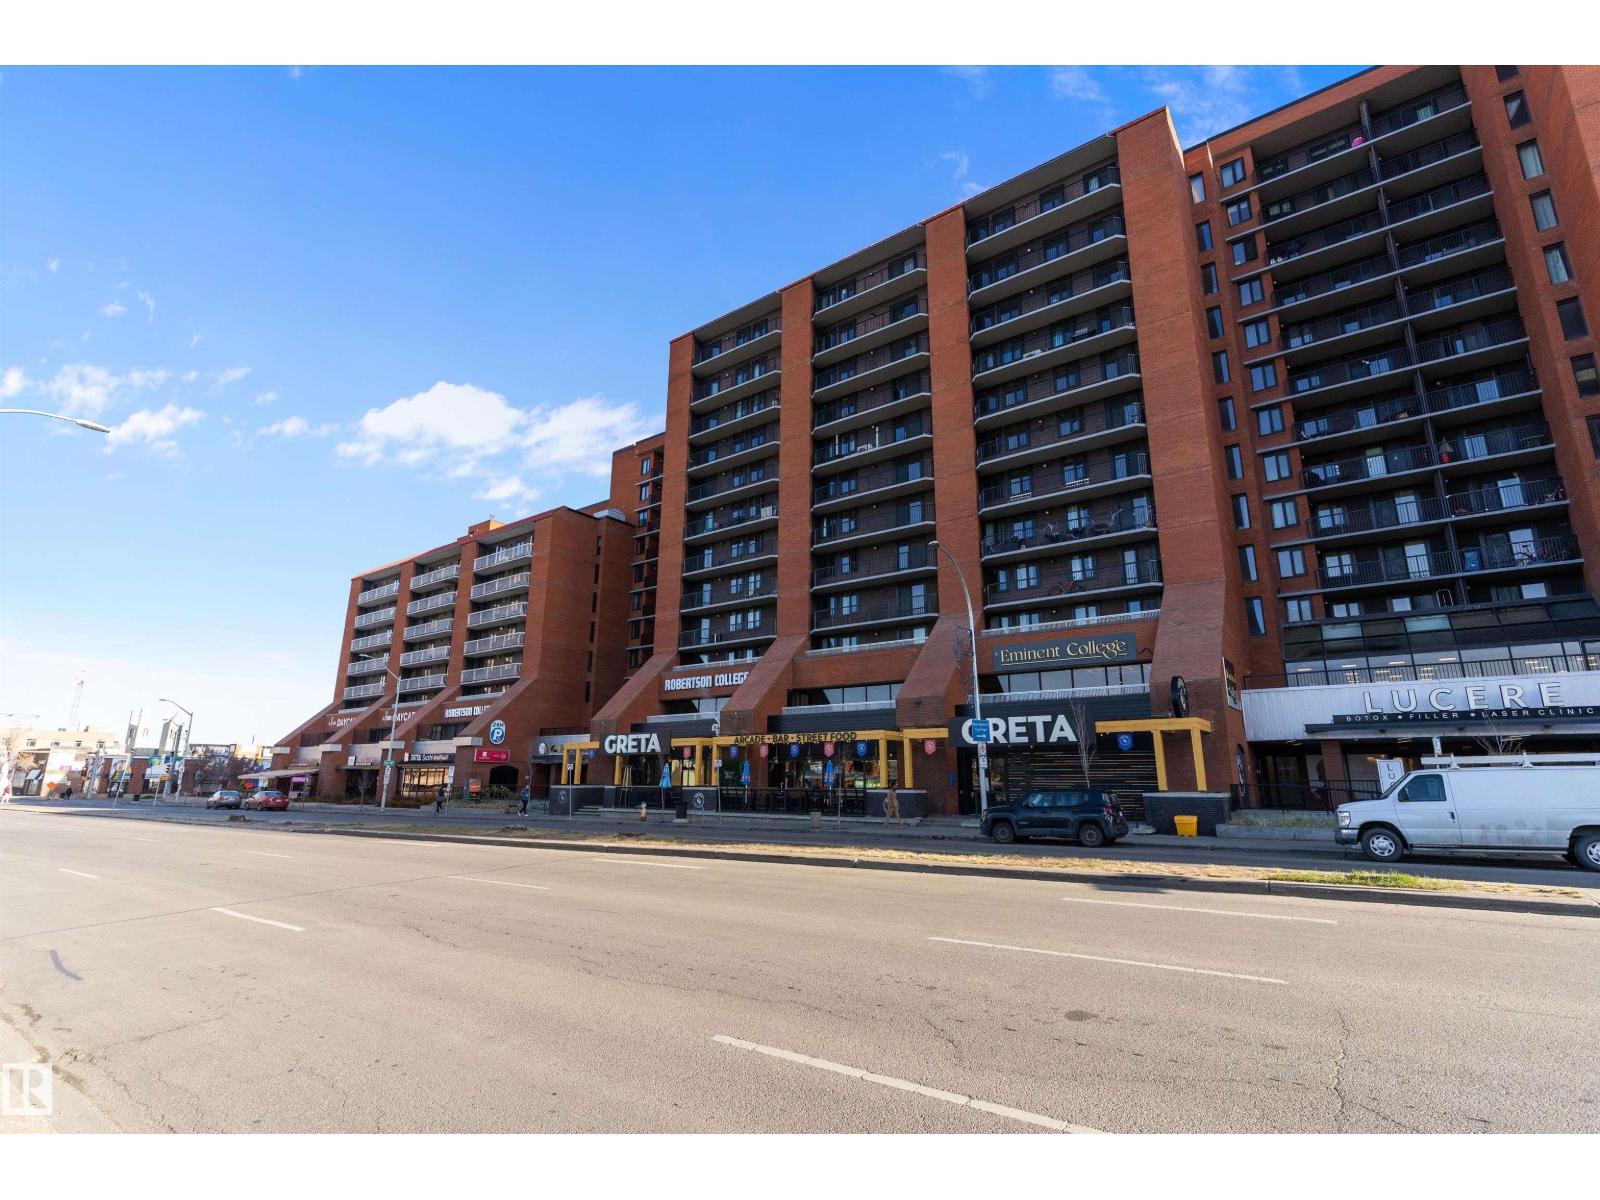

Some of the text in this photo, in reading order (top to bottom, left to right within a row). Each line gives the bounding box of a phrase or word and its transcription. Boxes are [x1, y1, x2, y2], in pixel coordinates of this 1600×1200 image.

[1000, 639, 1127, 663] Eminent College
[664, 675, 712, 691] ROBERTSON
[1362, 682, 1565, 714] LUCERE
[1346, 707, 1595, 722] BOTOX FILLER LASER CLINIC
[604, 733, 662, 754] GRETA
[734, 731, 857, 744] ARCADE BAR STREET FOOD
